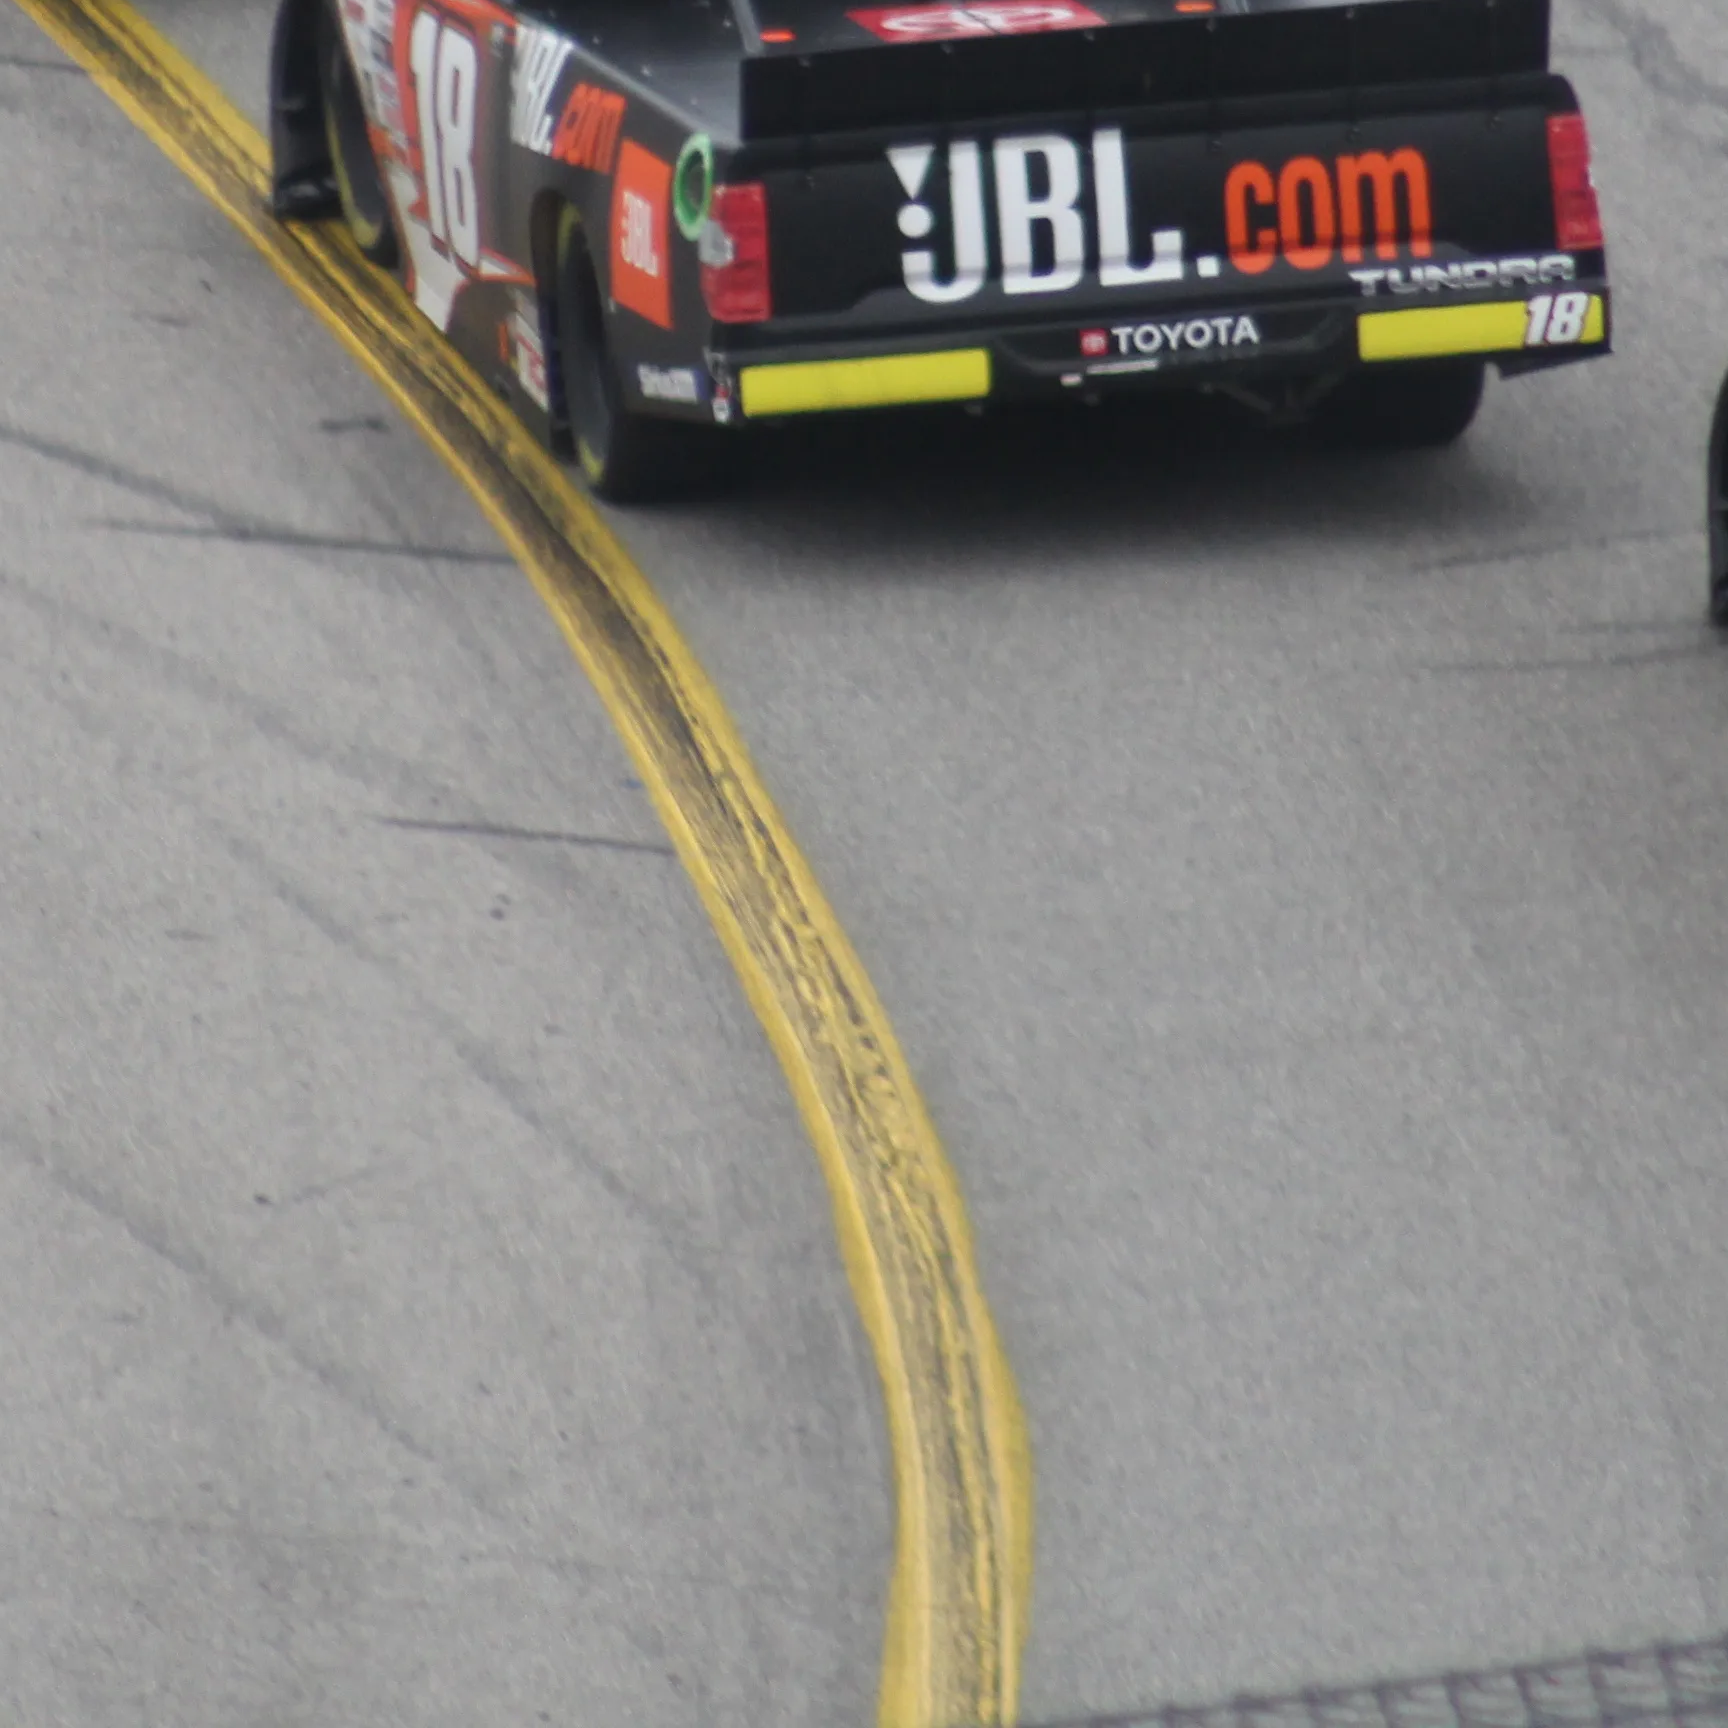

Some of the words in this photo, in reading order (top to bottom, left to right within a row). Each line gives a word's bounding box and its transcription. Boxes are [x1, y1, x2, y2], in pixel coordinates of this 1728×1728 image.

[407, 4, 480, 269] 18
[886, 126, 1433, 306] JBL.com
[1348, 254, 1575, 296] TUNDRA
[1110, 315, 1261, 355] TOYOTA
[1524, 292, 1590, 346] 18
